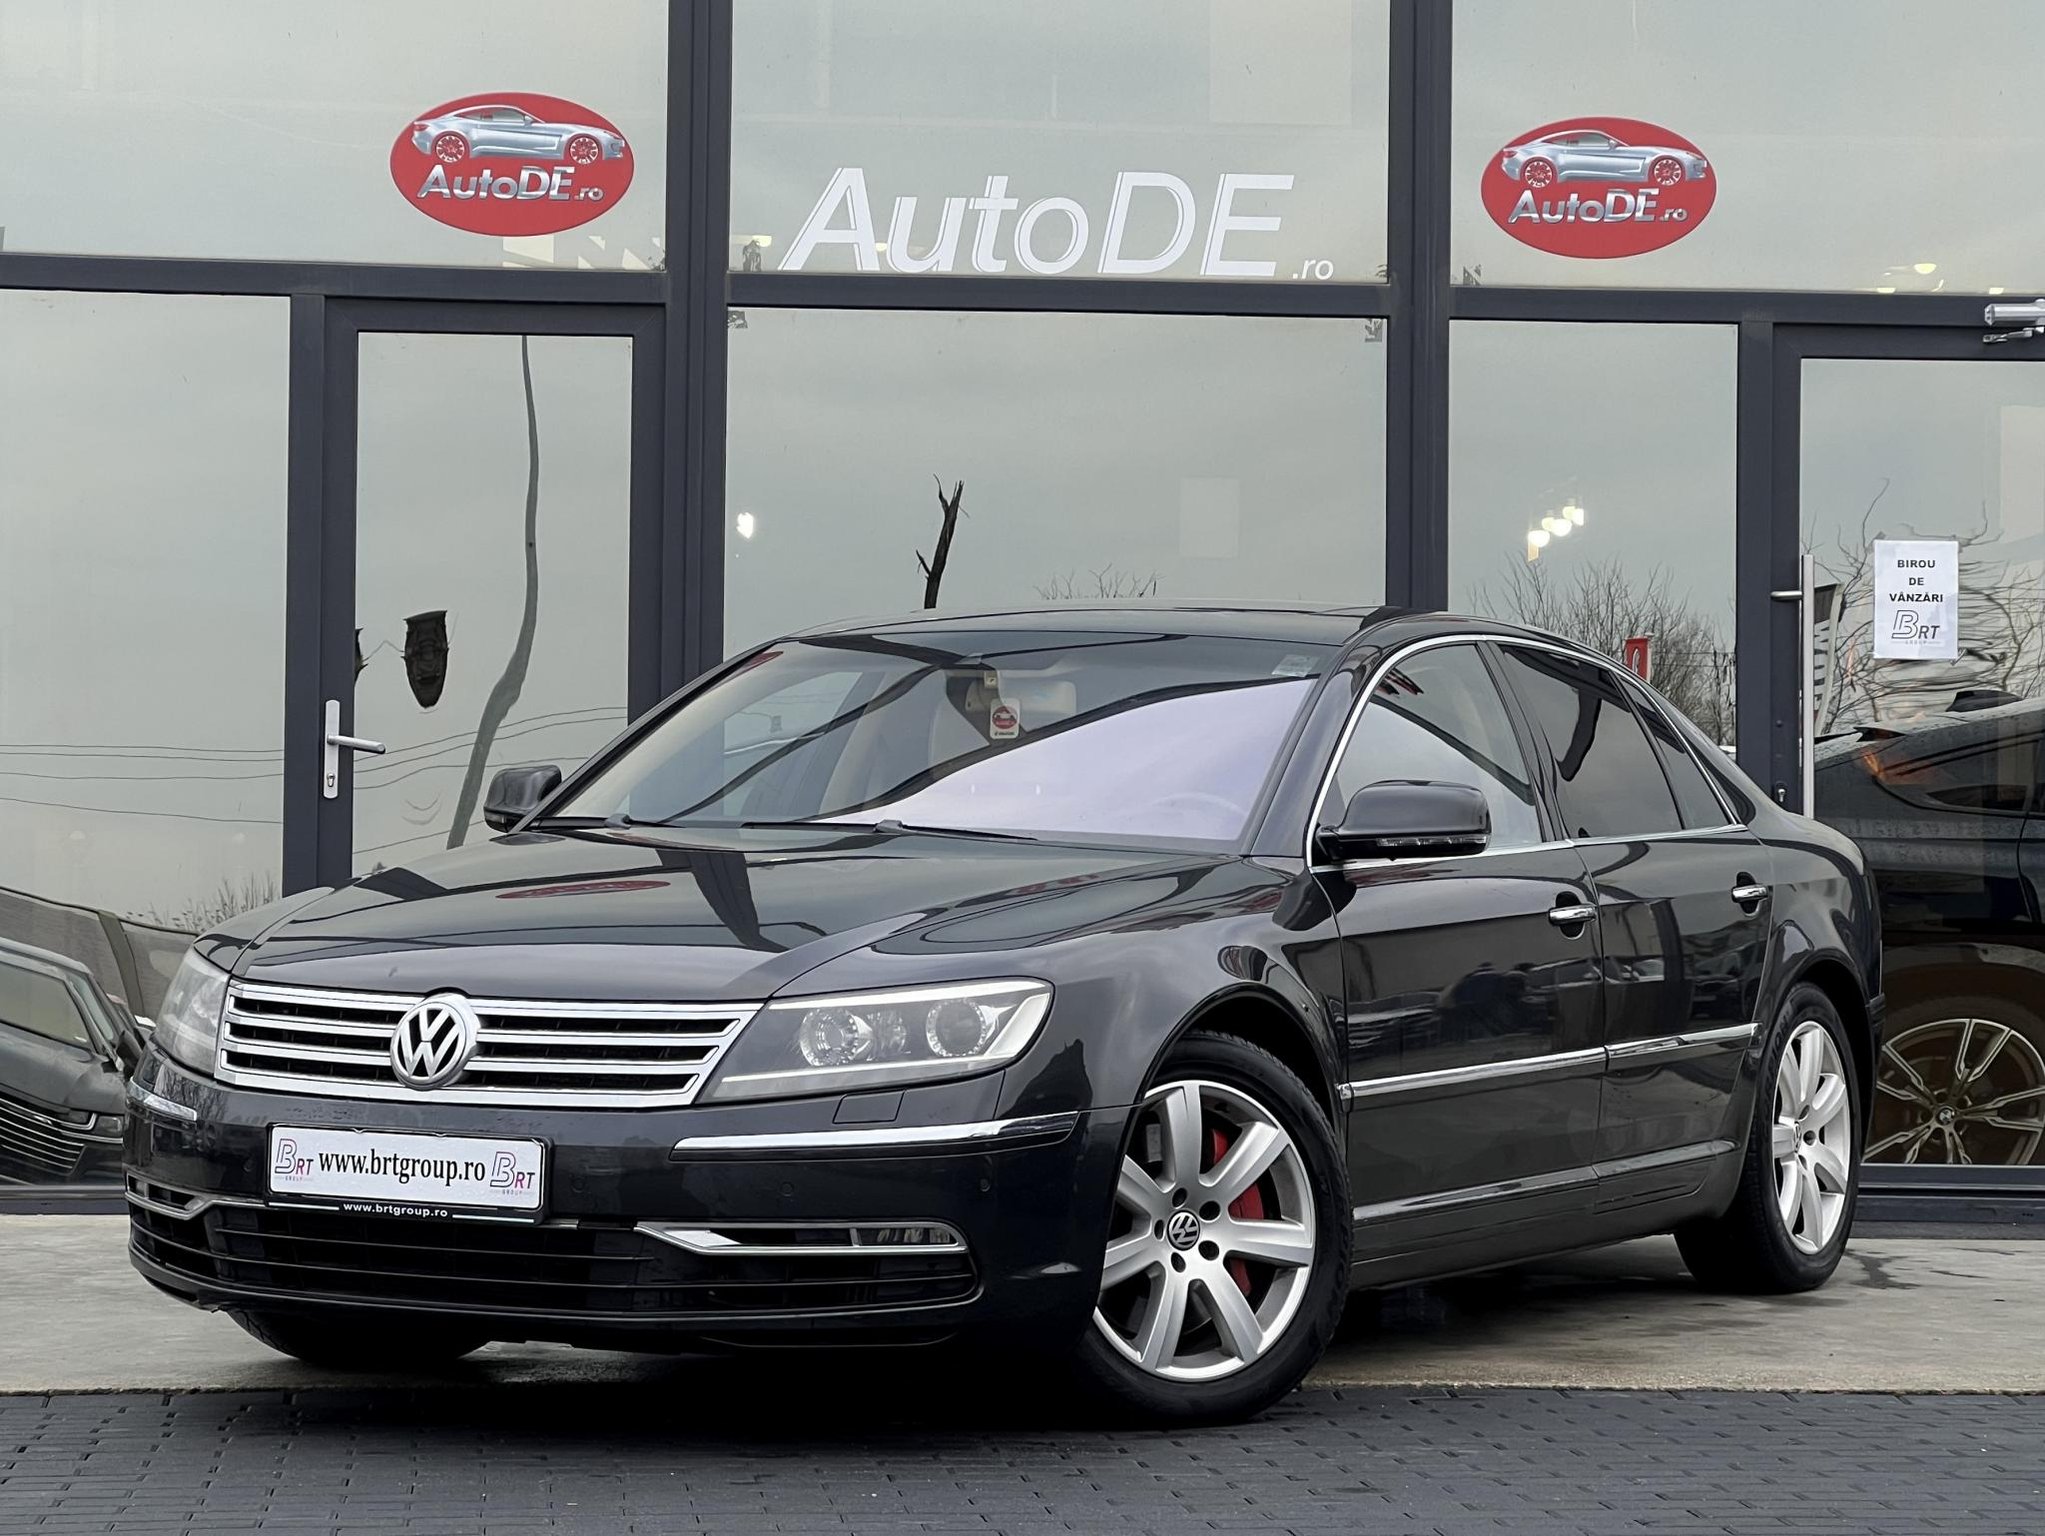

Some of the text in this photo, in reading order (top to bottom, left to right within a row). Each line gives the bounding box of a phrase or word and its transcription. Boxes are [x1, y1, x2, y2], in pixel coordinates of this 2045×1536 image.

[1897, 559, 1936, 568] BIROU
[1908, 577, 1924, 586] DE
[1891, 609, 1940, 639] BRT
[275, 1138, 536, 1189] BRT www.brtgroup.ro BRT
[343, 1203, 448, 1217] www.brtgroup.ro
